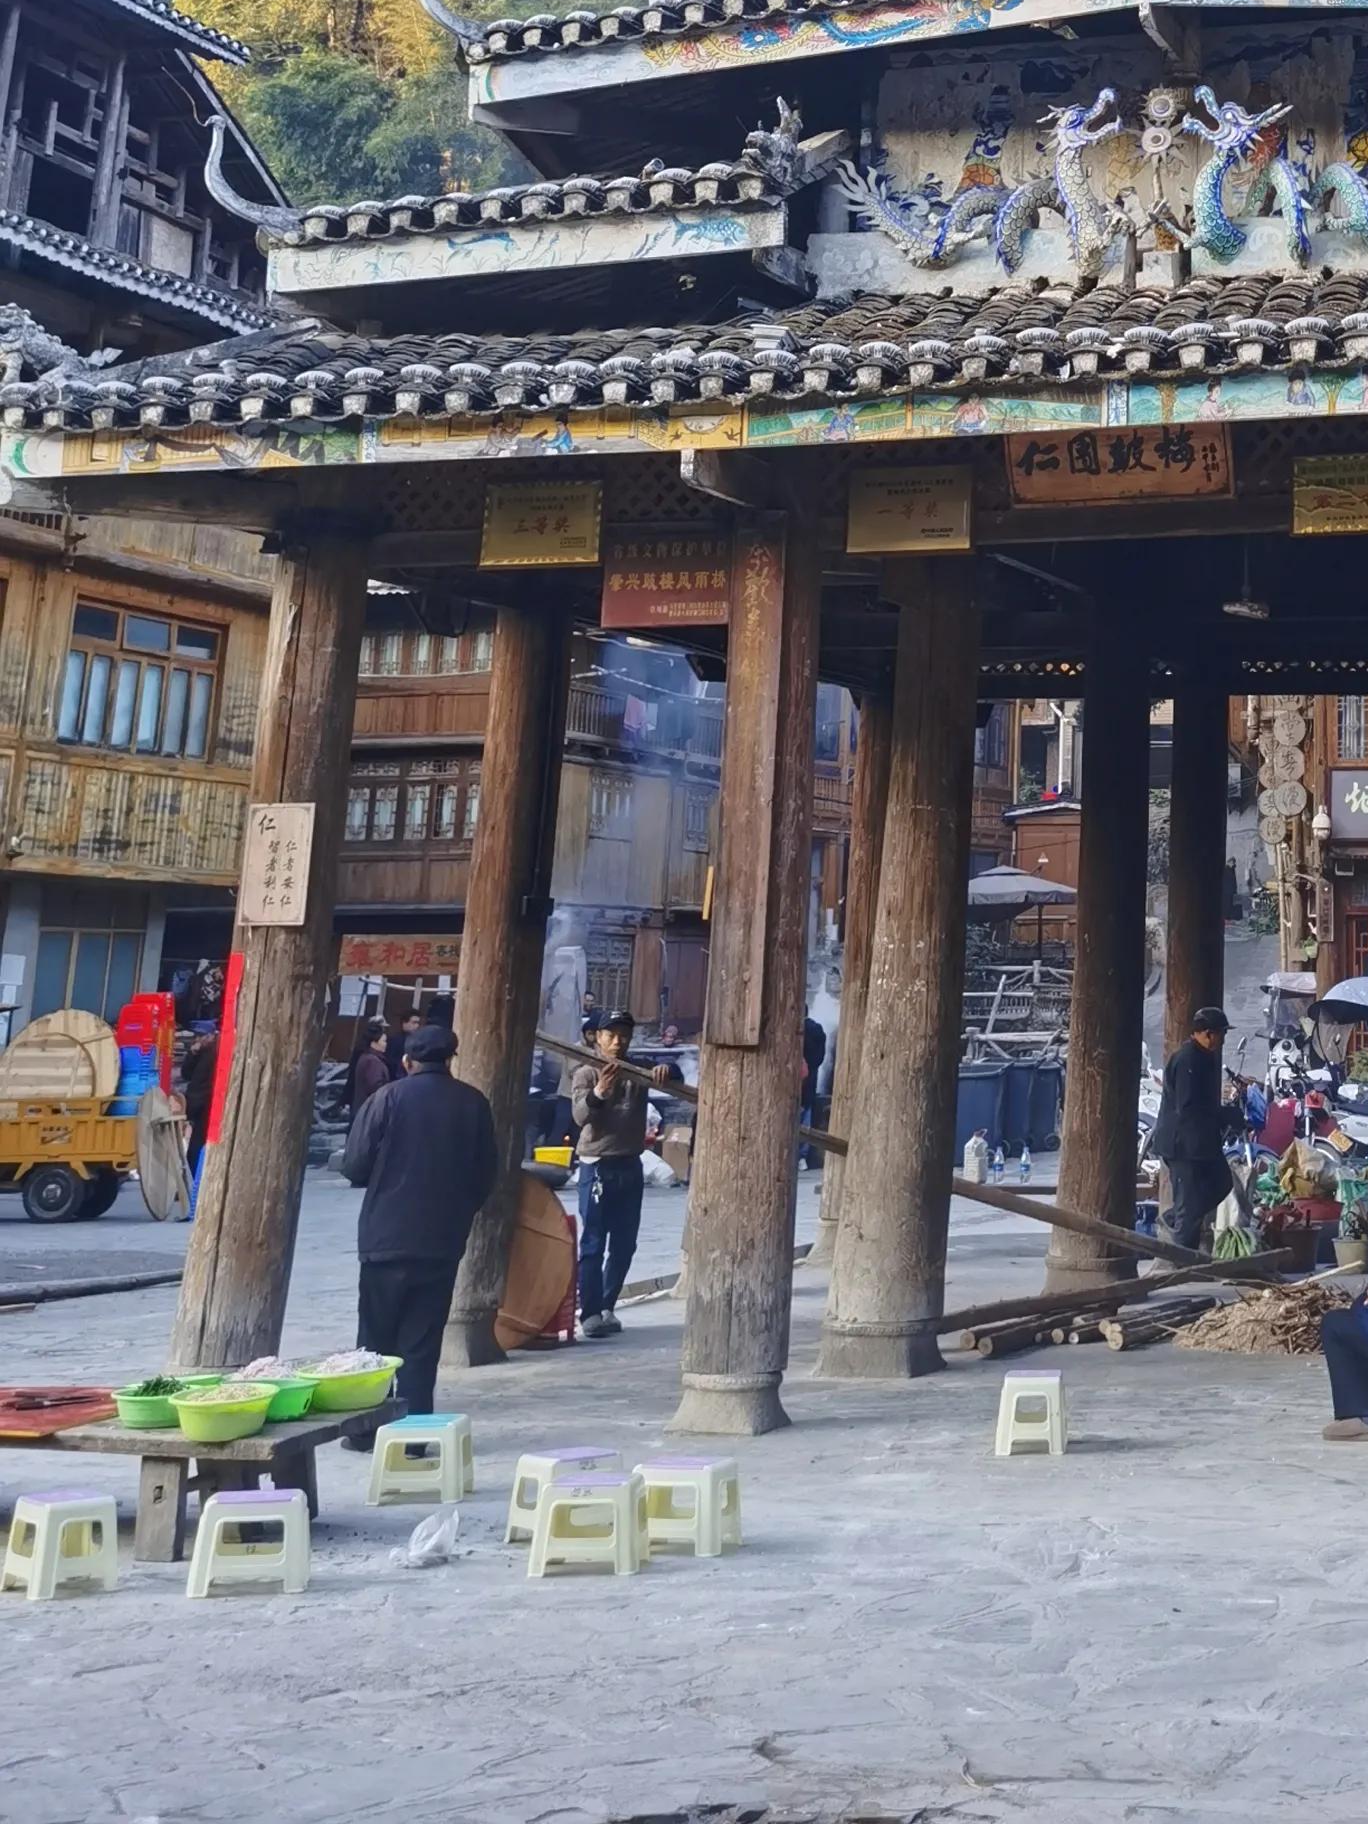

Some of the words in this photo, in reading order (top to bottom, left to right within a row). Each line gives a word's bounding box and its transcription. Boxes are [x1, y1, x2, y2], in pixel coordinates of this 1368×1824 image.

[608, 569, 727, 592] 肇兴鼓楼风雨桥
[258, 814, 277, 835] 仁
[262, 840, 281, 913] 智者利仁
[280, 840, 298, 909] 仁者安仁
